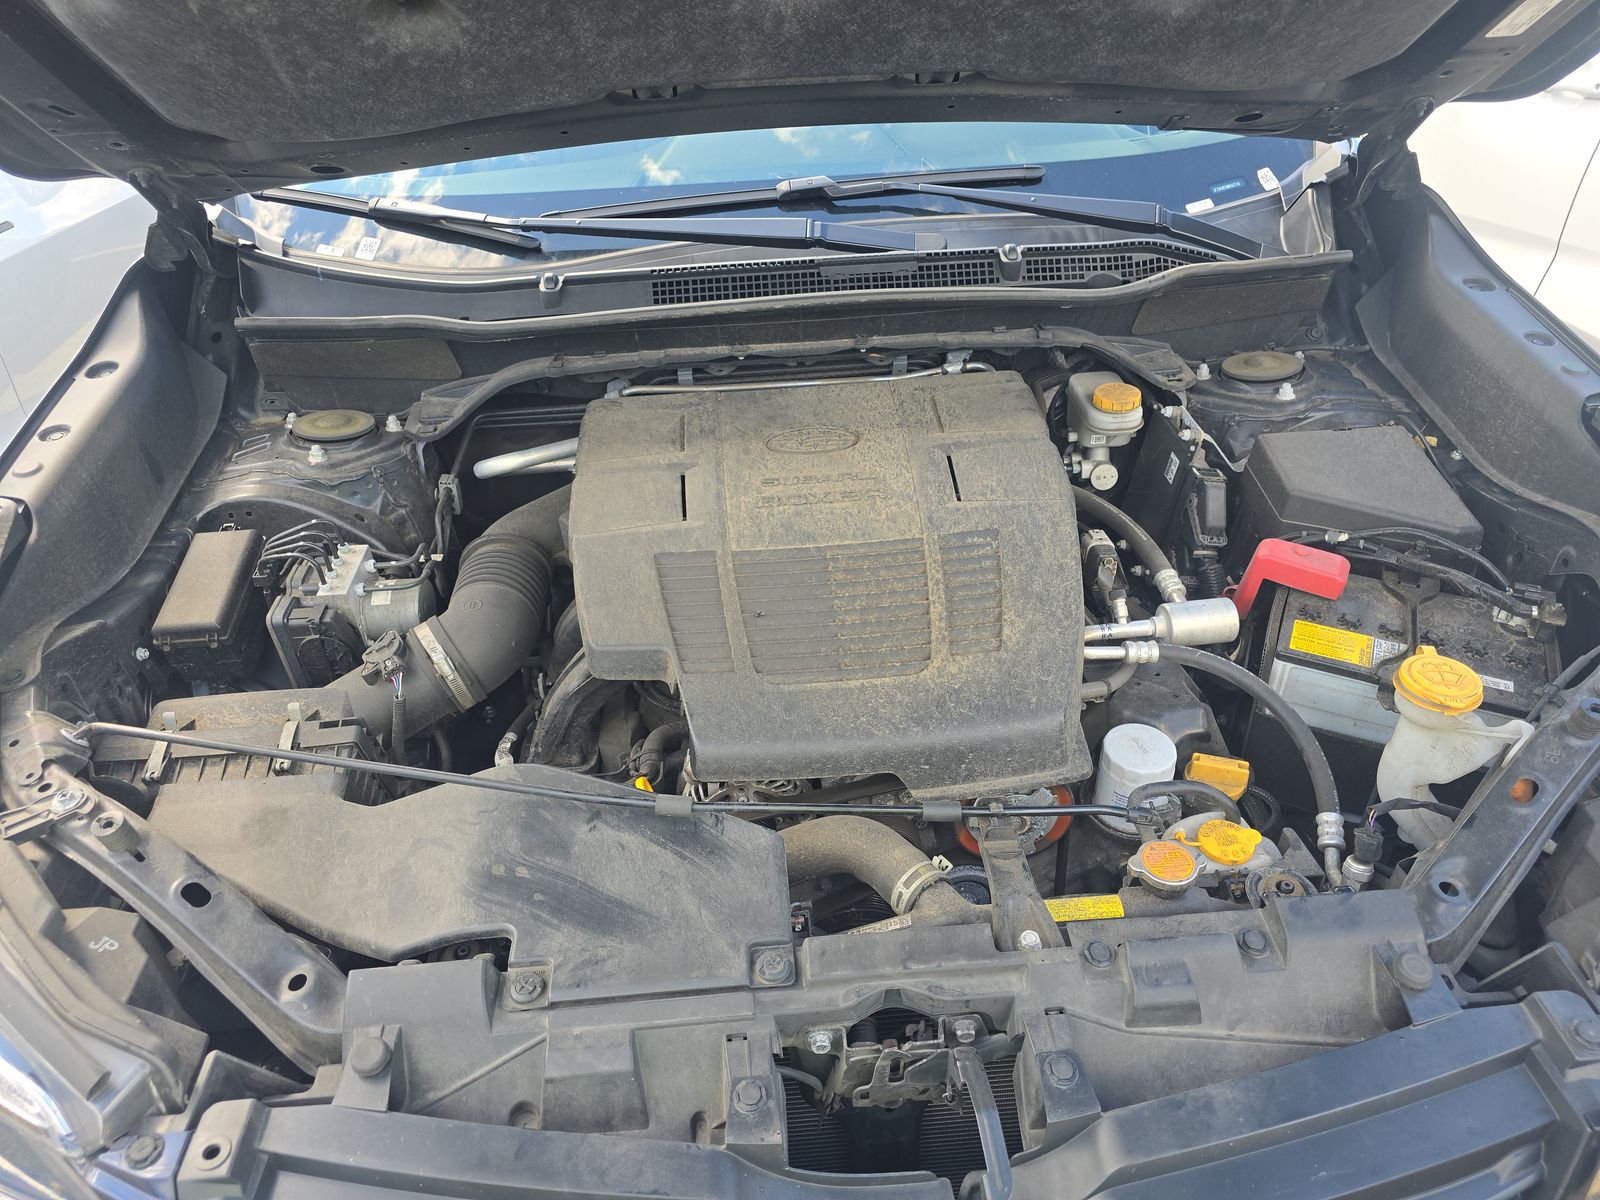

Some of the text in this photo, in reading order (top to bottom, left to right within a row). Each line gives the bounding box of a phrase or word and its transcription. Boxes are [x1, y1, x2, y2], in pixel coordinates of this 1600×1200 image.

[760, 472, 880, 487] SUBARU
[757, 488, 889, 508] BOXER
[89, 936, 118, 952] JP
